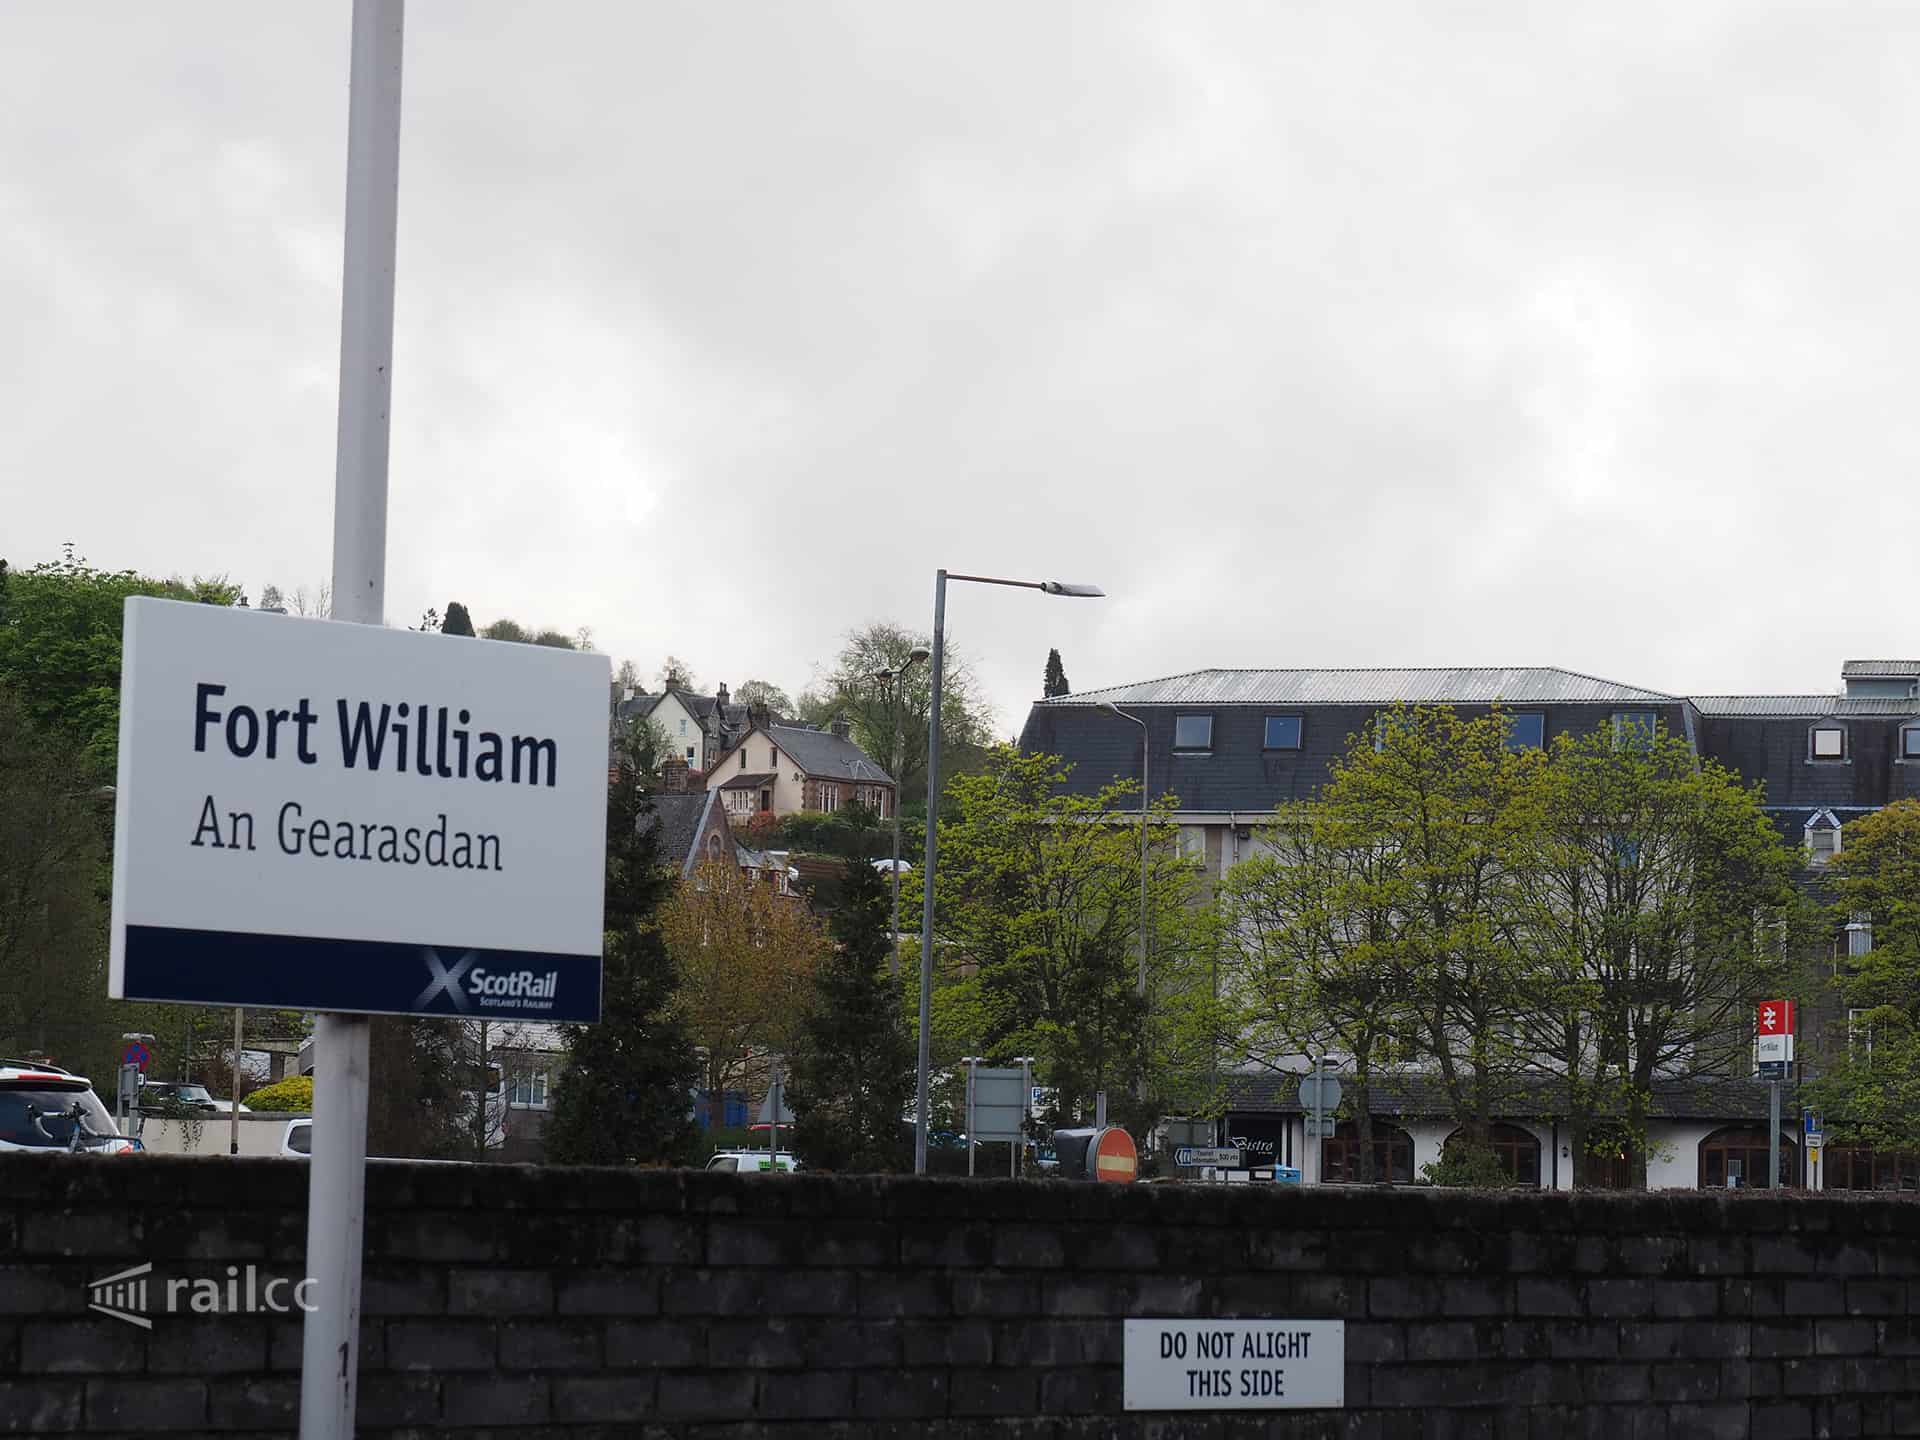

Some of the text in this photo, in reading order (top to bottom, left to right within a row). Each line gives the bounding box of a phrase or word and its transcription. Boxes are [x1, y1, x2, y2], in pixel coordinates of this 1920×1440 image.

[195, 683, 557, 787] Fort William
[191, 794, 503, 871] An Gearasdan
[468, 967, 558, 998] ScotRail
[1231, 1136, 1273, 1151] Bistro
[1160, 1331, 1311, 1359] DO NOT ALIGHT
[1187, 1369, 1284, 1397] THIS SIDE
